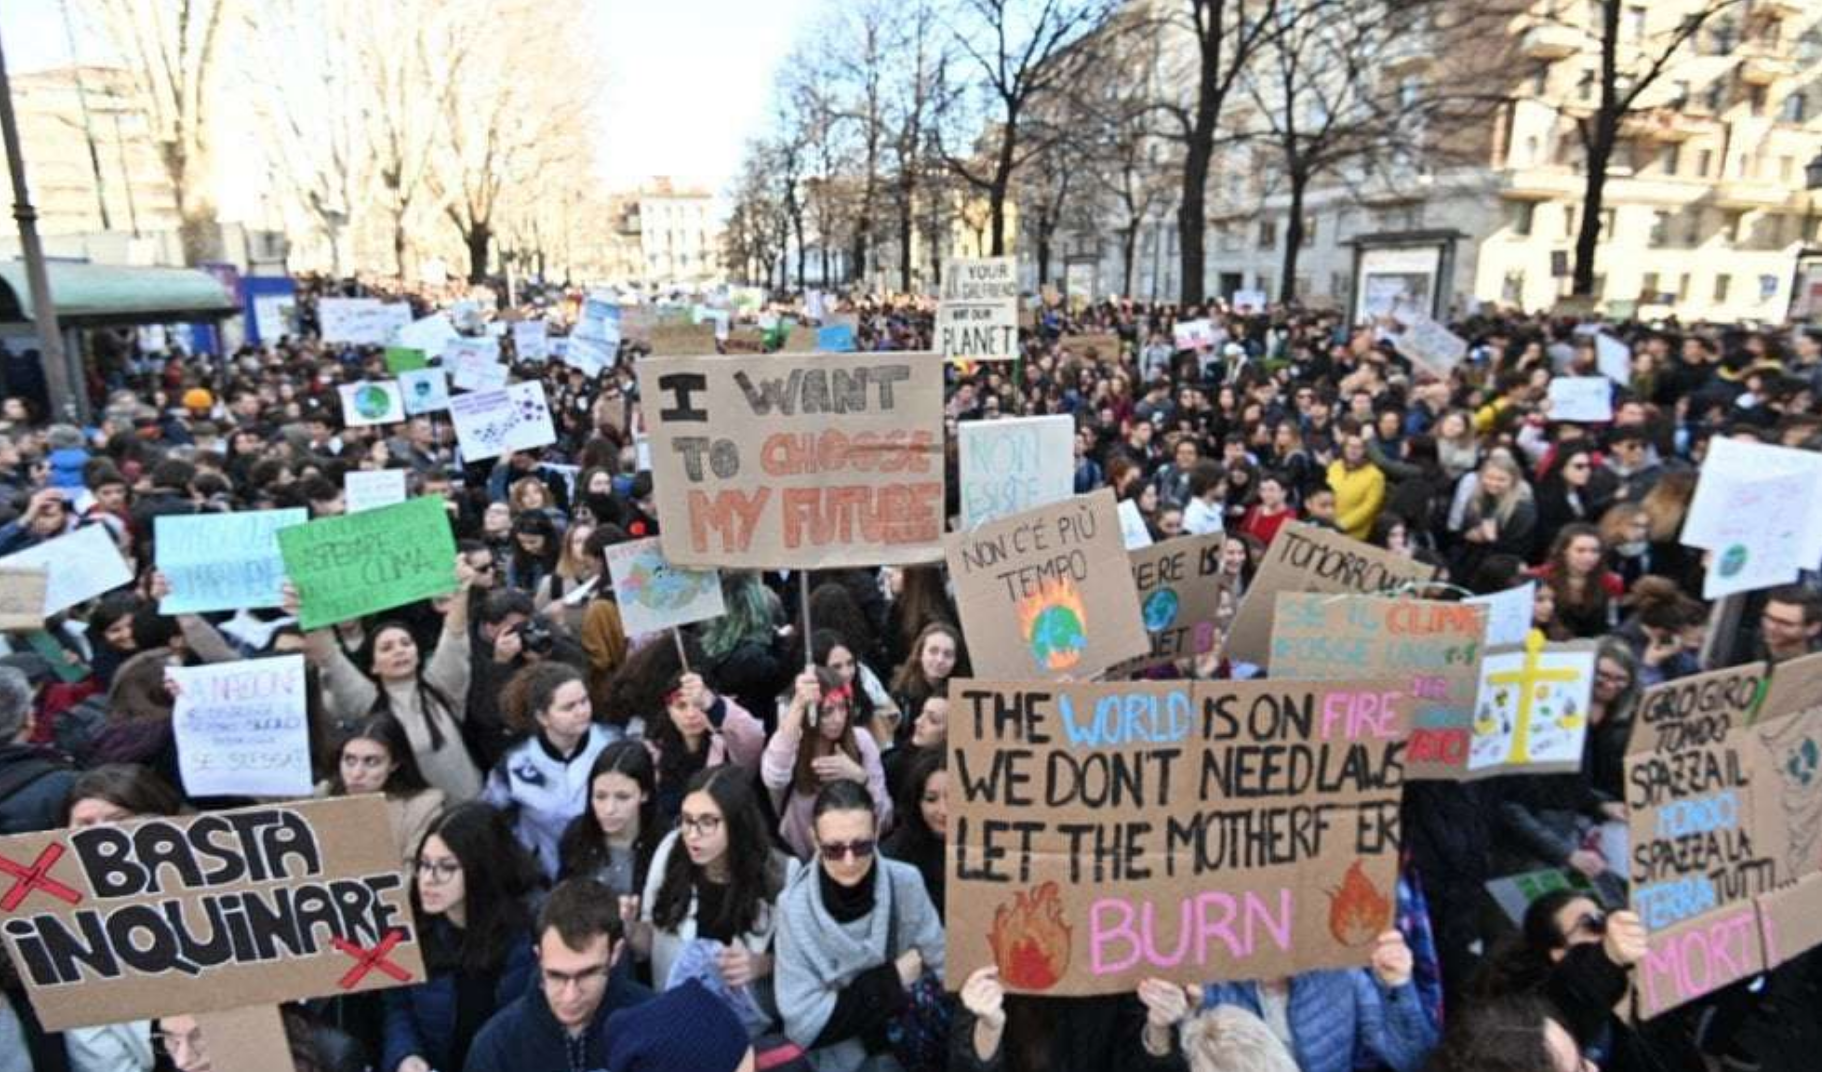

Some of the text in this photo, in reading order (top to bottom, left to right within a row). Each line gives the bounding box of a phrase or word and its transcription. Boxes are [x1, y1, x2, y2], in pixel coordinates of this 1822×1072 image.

[969, 264, 1011, 279] YOUR
[942, 324, 1015, 357] PLANET
[658, 364, 910, 422] I WANT
[671, 428, 934, 482] TO CHOOSE
[686, 482, 942, 554] MY FUTURE
[962, 534, 1007, 574] NON
[1057, 504, 1097, 545] PIÙ
[996, 549, 1088, 603] TEMPO
[1133, 544, 1221, 592] ERE IS
[1386, 603, 1484, 637] CLIMA
[961, 691, 1052, 744] THE
[1058, 690, 1197, 746] WORLD
[1203, 692, 1240, 742] IS
[1247, 692, 1315, 742] ON
[1319, 691, 1402, 741] FIRE
[1654, 713, 1732, 754] TONDO
[954, 741, 1409, 808] WE DON'T NEED LAWS
[1630, 748, 1749, 811] SPAZZA IL
[72, 809, 321, 899] BASTA
[955, 817, 1046, 883] LET
[1056, 821, 1153, 884] THE
[1631, 827, 1752, 884] SPAZZA LA
[1087, 887, 1294, 977] BURN
